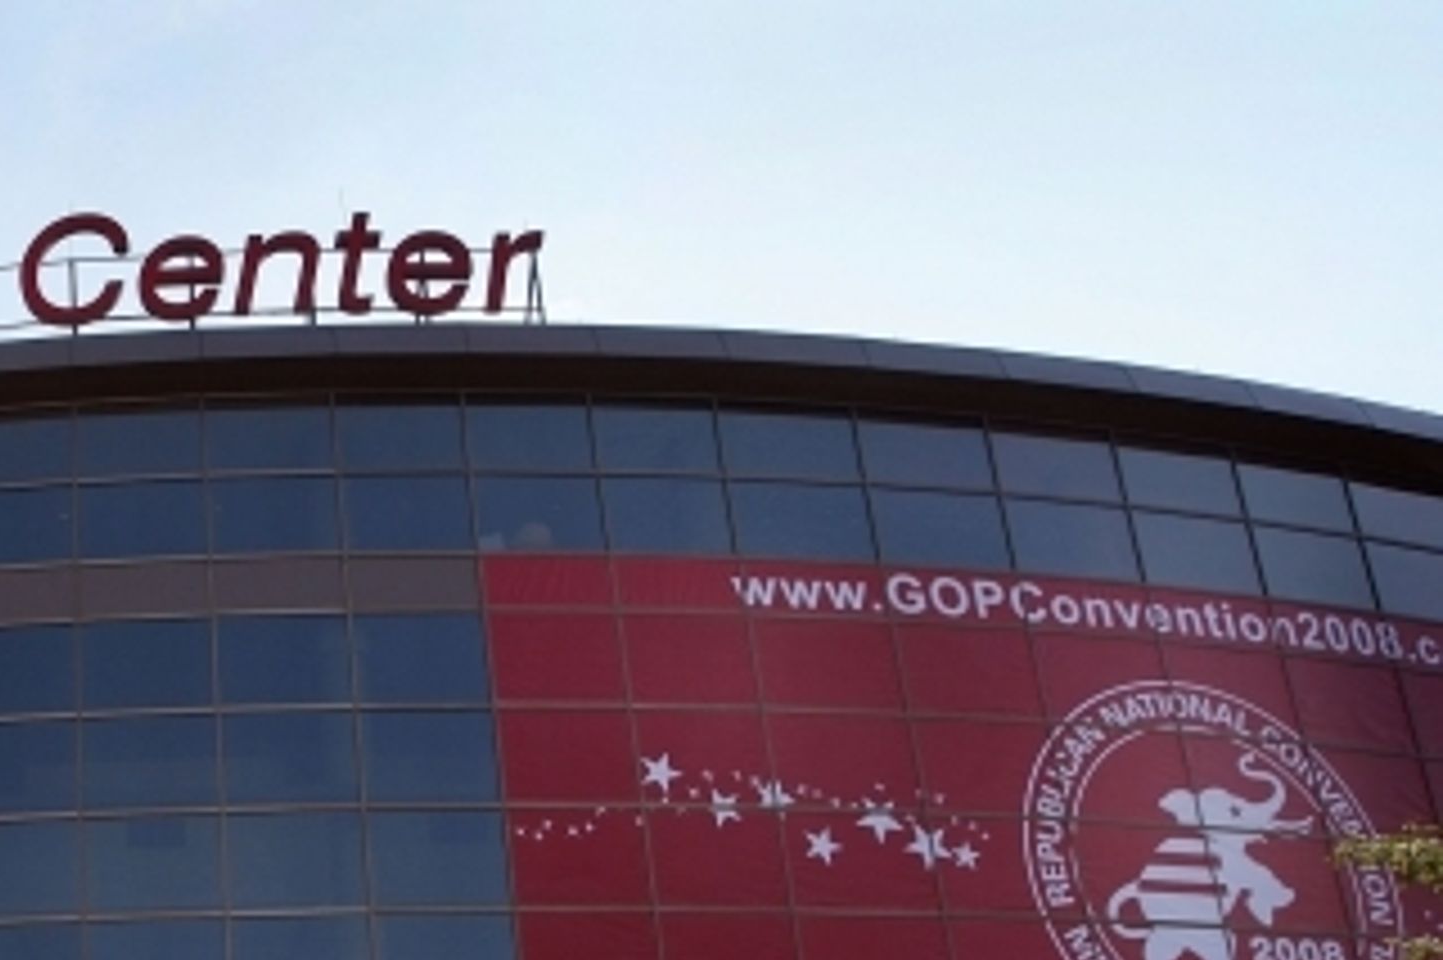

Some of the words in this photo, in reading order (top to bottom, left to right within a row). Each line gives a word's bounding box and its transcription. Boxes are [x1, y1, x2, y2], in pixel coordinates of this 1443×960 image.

[19, 212, 544, 325] Center
[1036, 716, 1105, 907] REPUBLICAN
[1099, 692, 1251, 737] NATIONAL
